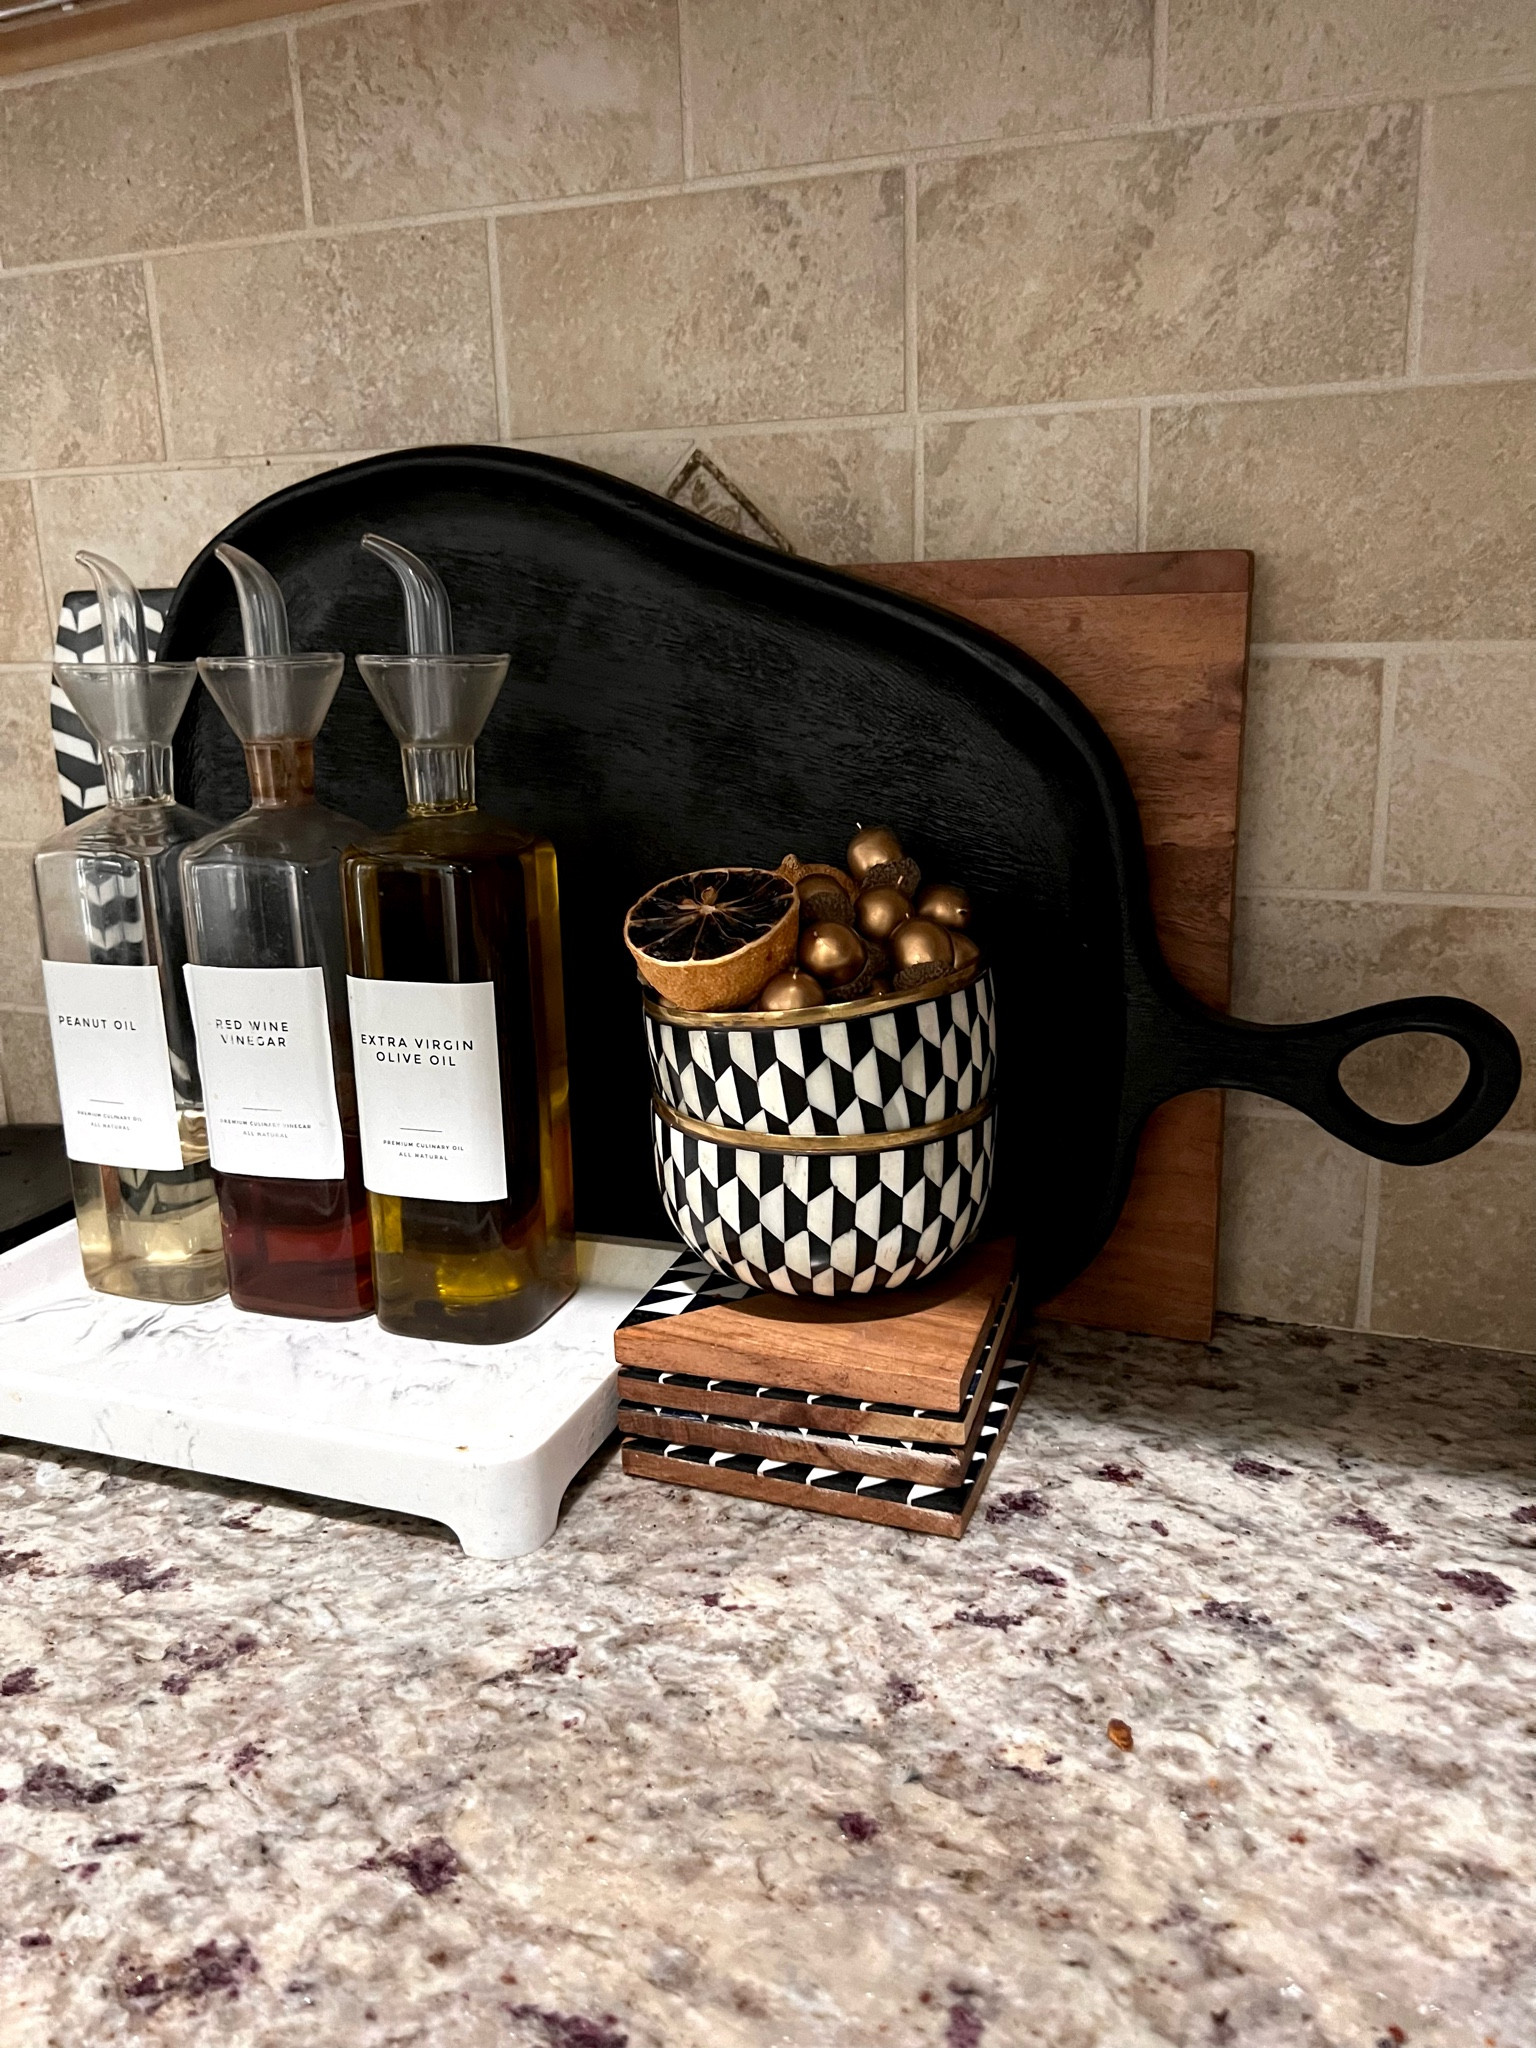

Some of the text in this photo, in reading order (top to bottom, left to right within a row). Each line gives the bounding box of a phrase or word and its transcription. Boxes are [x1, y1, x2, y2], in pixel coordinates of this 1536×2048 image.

[58, 1015, 137, 1031] PEANUT OIL
[215, 1018, 289, 1032] RED WINE
[220, 1034, 287, 1047] VINEGAR
[361, 1034, 473, 1051] EXTRA VIRGIN
[376, 1051, 456, 1067] OLIVE OIL
[383, 1139, 414, 1147] PREMIUM
[416, 1142, 450, 1150] CULINARY
[414, 1153, 449, 1161] NATURAL
